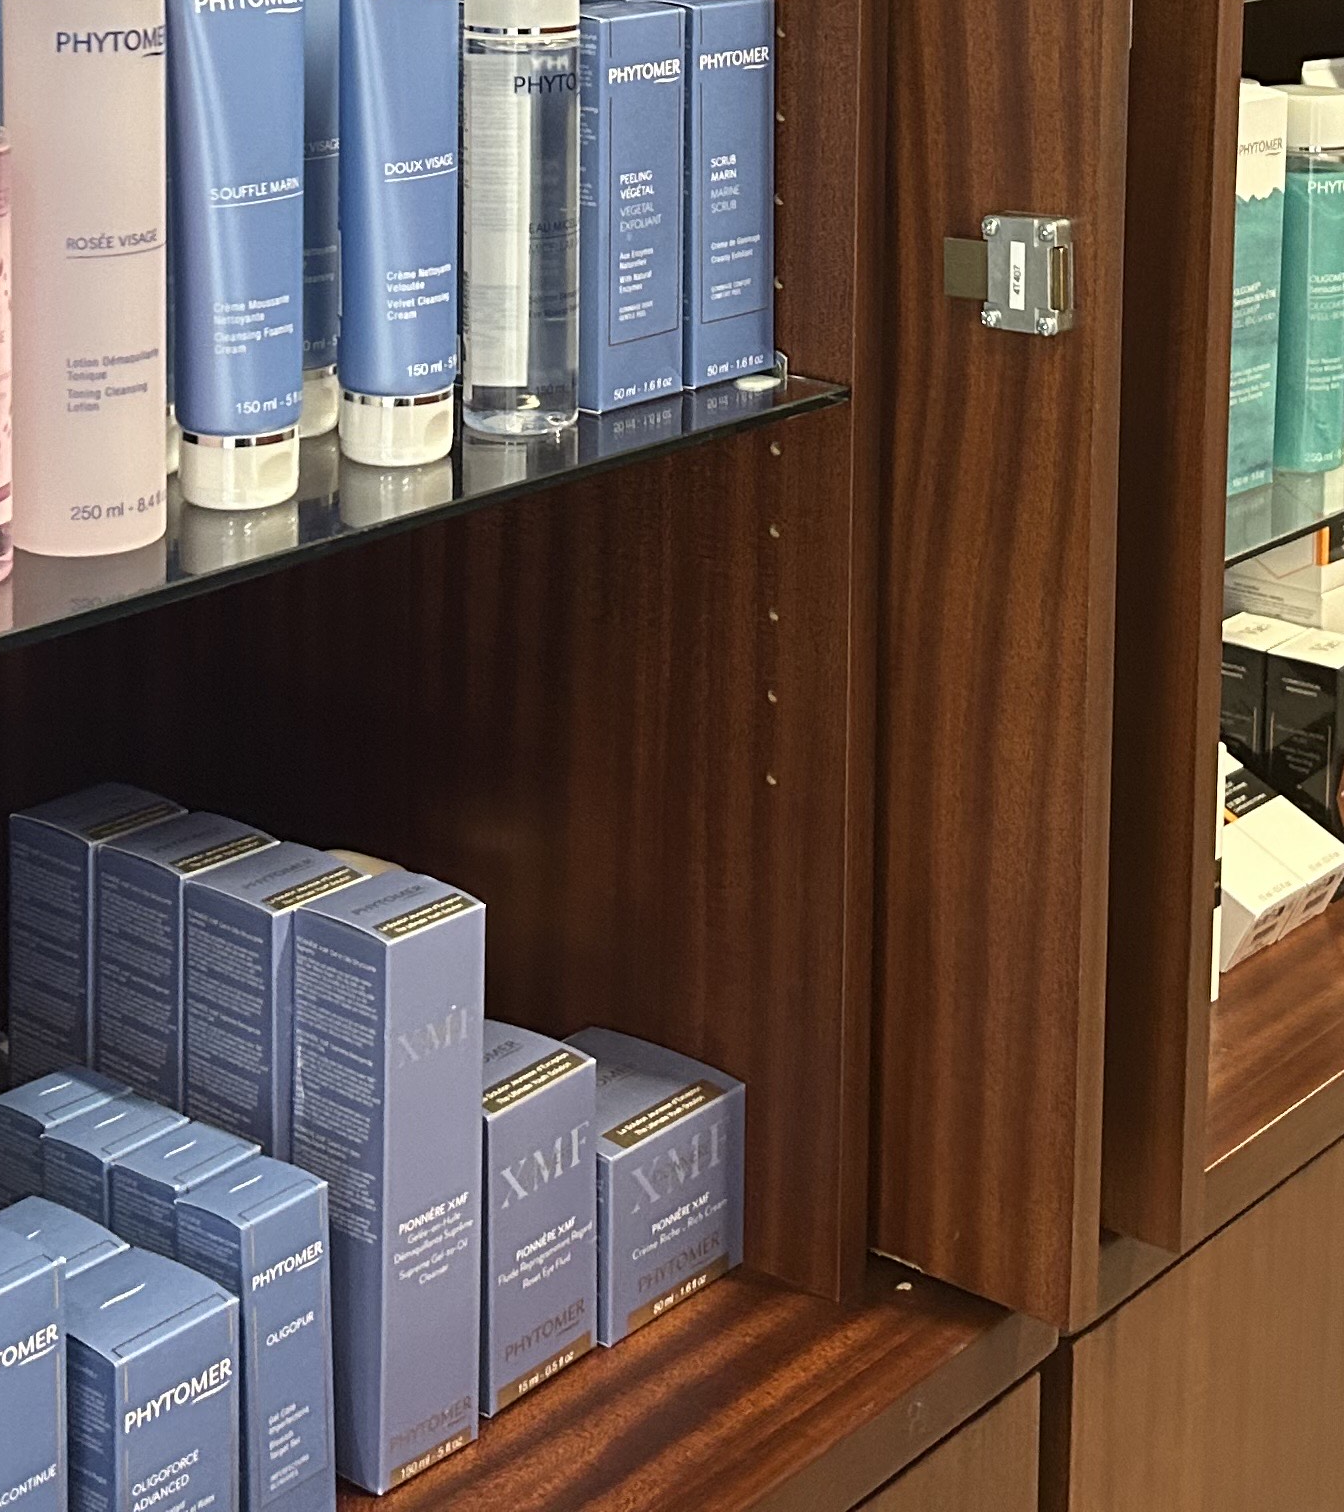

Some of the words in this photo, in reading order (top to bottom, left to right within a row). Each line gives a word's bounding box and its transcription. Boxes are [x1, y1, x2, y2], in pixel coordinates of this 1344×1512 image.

[699, 46, 770, 72] PHYTOMER
[608, 58, 681, 85] PHYTOMER
[1239, 136, 1284, 157] PHYTOMER
[384, 160, 423, 176] DOUX
[425, 153, 454, 170] VISAGE
[710, 154, 737, 170] SCRUB
[619, 170, 653, 186] PEELING
[710, 168, 738, 183] MARIN
[210, 182, 268, 202] SOUFFLE
[619, 183, 656, 201] VÉGÉTAL
[66, 231, 113, 251] ROSÉE
[118, 228, 158, 248] VISAGE
[386, 297, 414, 311] Velvet
[386, 310, 417, 322] Cream
[406, 363, 429, 378] 150
[430, 359, 443, 374] ml
[707, 365, 721, 378] 50
[736, 359, 748, 372] 1.6
[613, 389, 628, 402] 50
[629, 386, 638, 399] ml
[643, 382, 656, 396] 1.6
[235, 399, 261, 416] 150
[262, 396, 277, 412] ml
[70, 504, 102, 522] 250
[106, 502, 125, 519] ml
[500, 1119, 591, 1210] XMF
[446, 1191, 470, 1212] XMF
[252, 1240, 324, 1292] PHYTOMER
[638, 1230, 721, 1294] PHYTOMER
[266, 1310, 315, 1347] OLIGOPUR
[506, 1297, 587, 1363] PHYTOMER
[123, 1357, 234, 1434] PHYTOMER
[131, 1448, 200, 1497] OLIGOFORCE
[132, 1473, 191, 1512] ADVANCED
